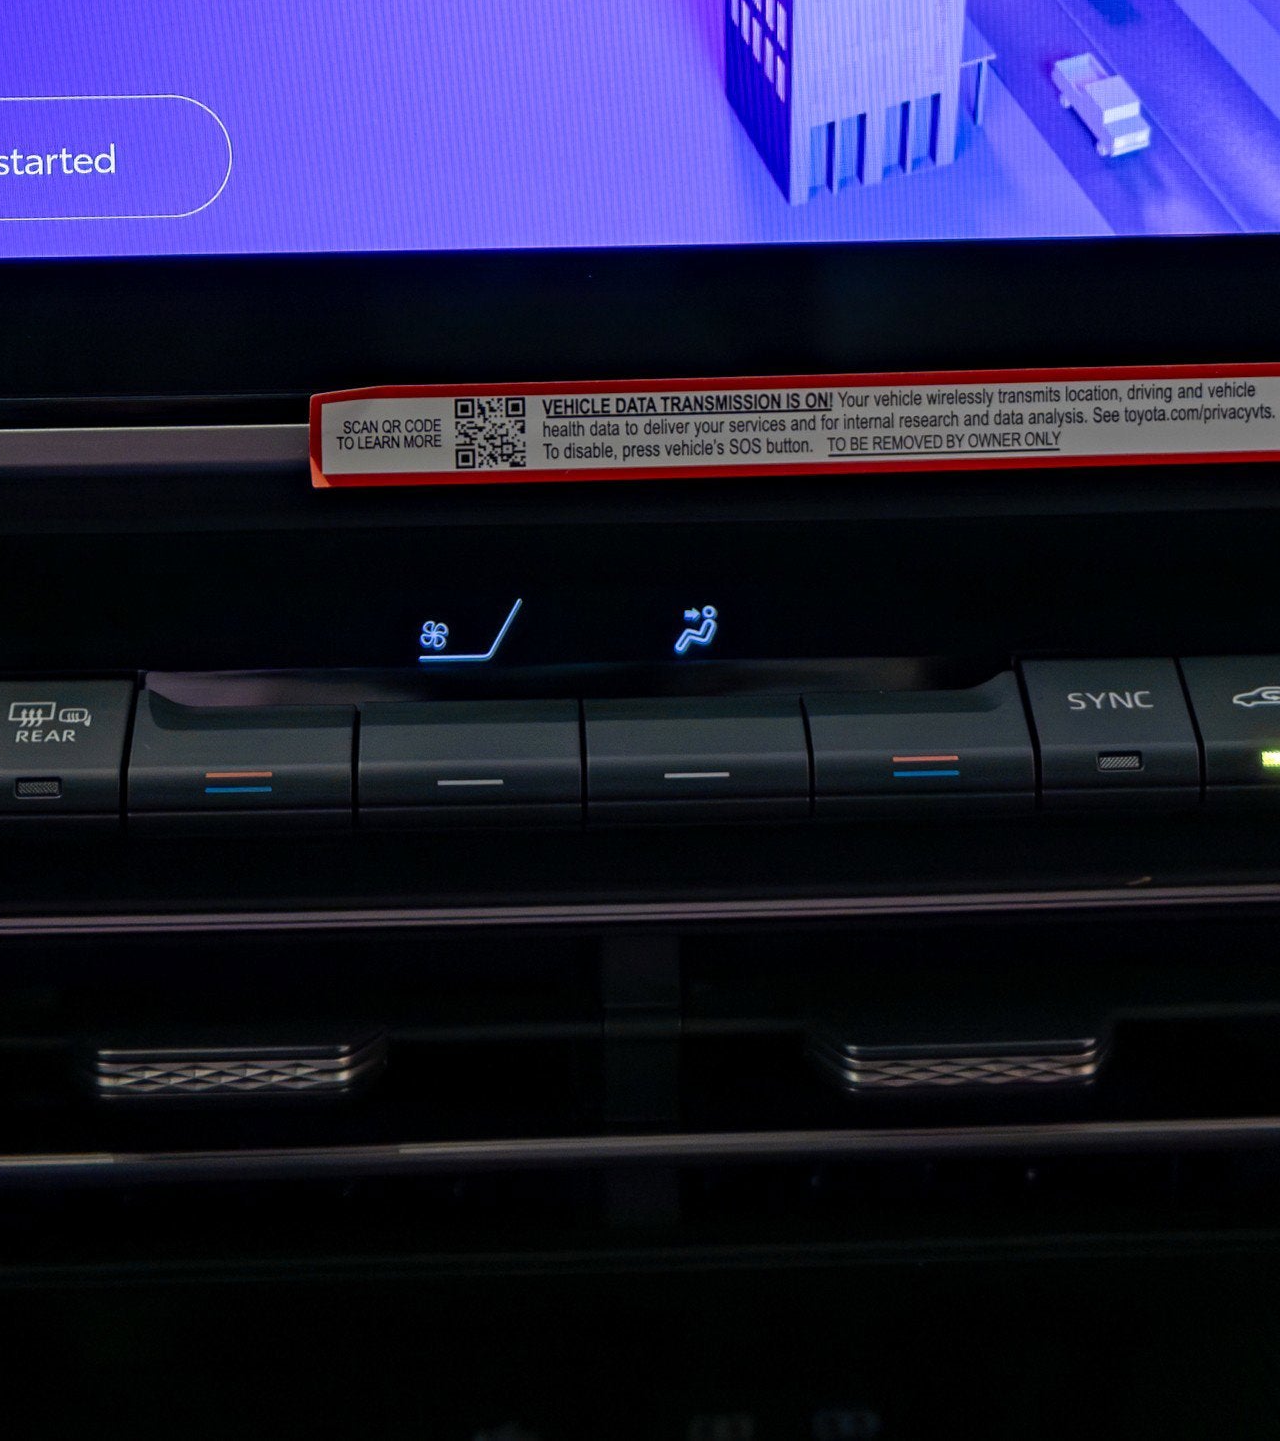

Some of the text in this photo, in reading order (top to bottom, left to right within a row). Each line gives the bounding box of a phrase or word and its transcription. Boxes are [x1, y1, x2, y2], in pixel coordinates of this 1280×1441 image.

[542, 381, 1255, 415] VEHICLE DATA TRANSMISSION IS ON! Your vehicle wirelessly transmits location, driving and vehicle
[343, 419, 441, 434] SCAN QR CODE
[542, 404, 1276, 438] health data to deliver your services and for internal research and data analysis. See toyota.com/privacyvts.
[337, 434, 442, 450] TO LEARN MORE
[542, 443, 559, 459] To
[564, 441, 618, 460] disable,
[622, 444, 660, 461] press
[729, 438, 761, 454] SOS
[766, 437, 813, 453] button.
[827, 436, 847, 451] TO
[850, 436, 868, 451] BE
[872, 434, 943, 450] REMOVED
[946, 433, 965, 448] BY
[967, 432, 1021, 447] OWNER
[1024, 431, 1061, 446] ONLY
[1067, 690, 1154, 711] SYNC
[15, 729, 76, 743] REAR
